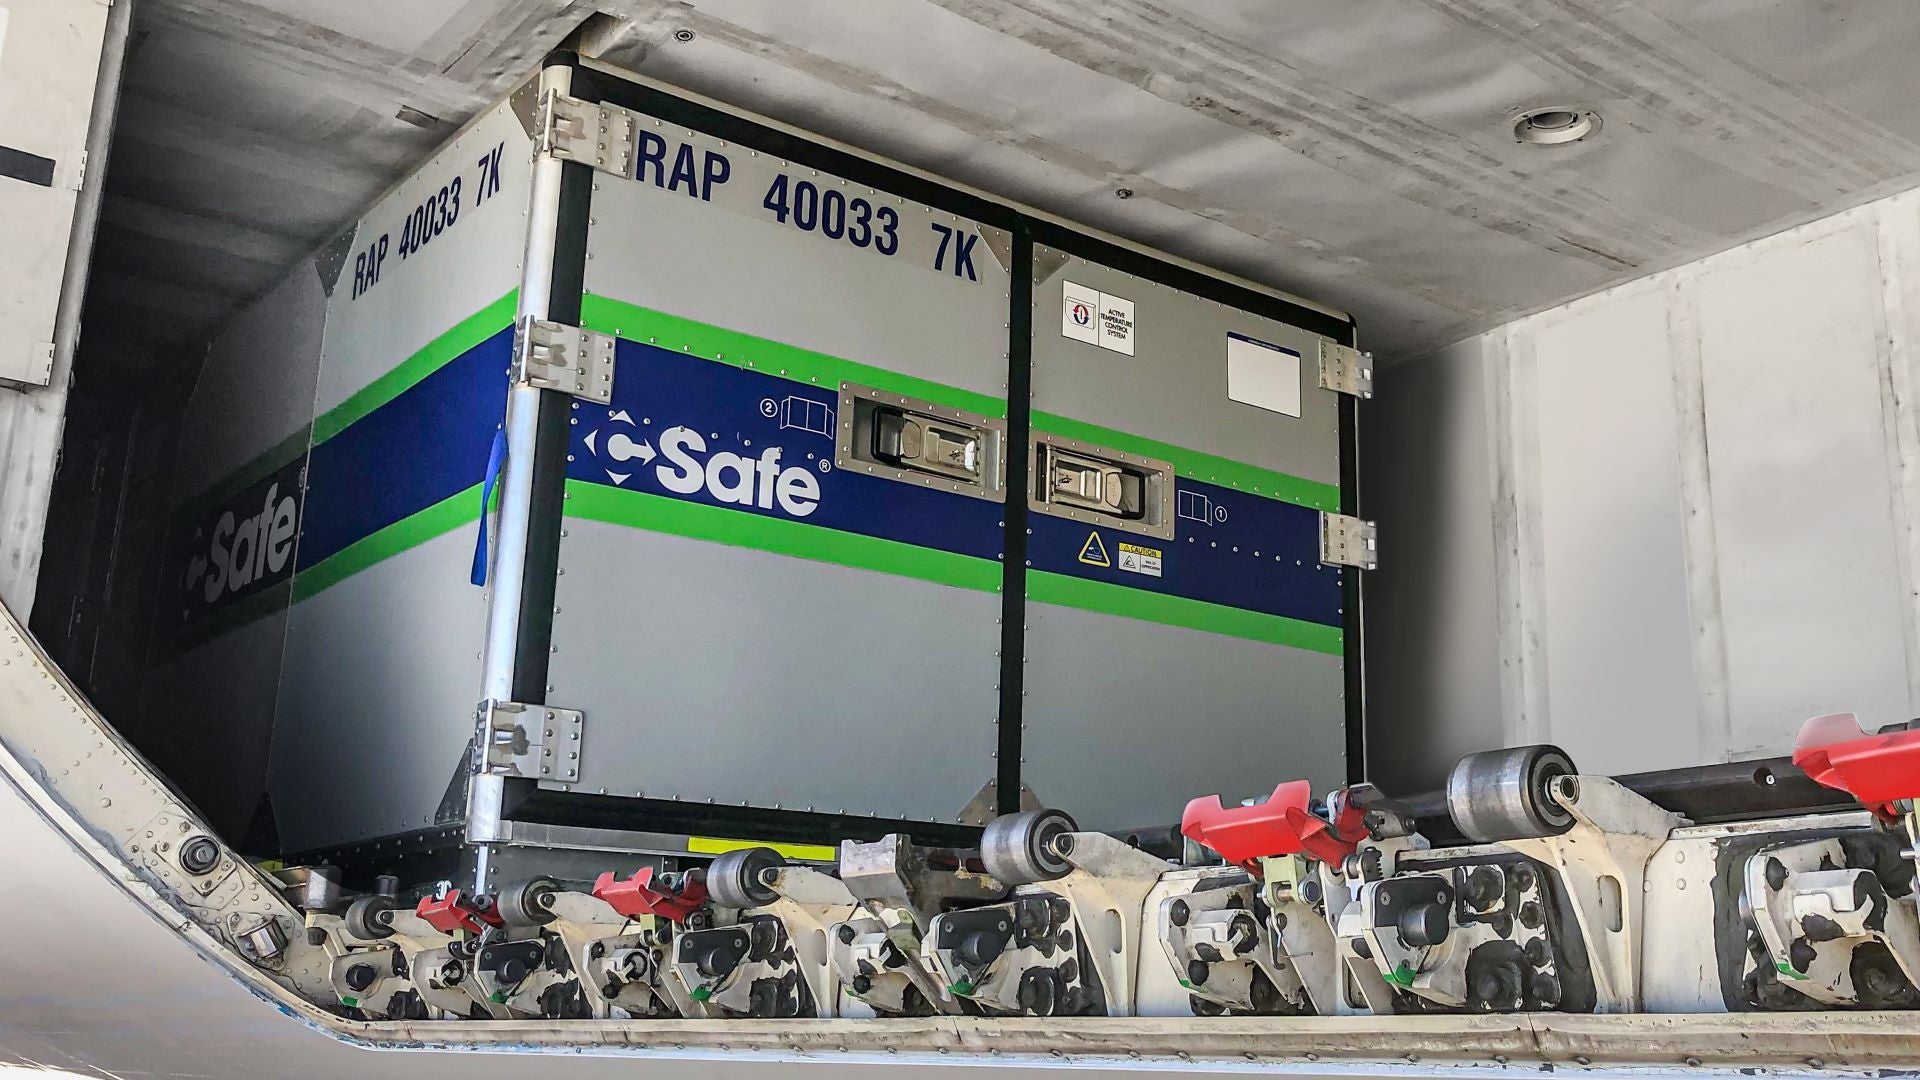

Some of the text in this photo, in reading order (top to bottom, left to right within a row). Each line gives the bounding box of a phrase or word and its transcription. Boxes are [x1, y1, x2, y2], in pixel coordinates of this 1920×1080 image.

[636, 129, 979, 282] RAP 40033 7K
[352, 141, 505, 301] RAP 40033 7K
[1108, 308, 1126, 319] ACTIVE
[1100, 312, 1133, 329] TEMPERATURE
[1104, 321, 1129, 334] CONTROL
[1107, 329, 1127, 340] SYSTEM
[1130, 545, 1157, 558] CAUTION
